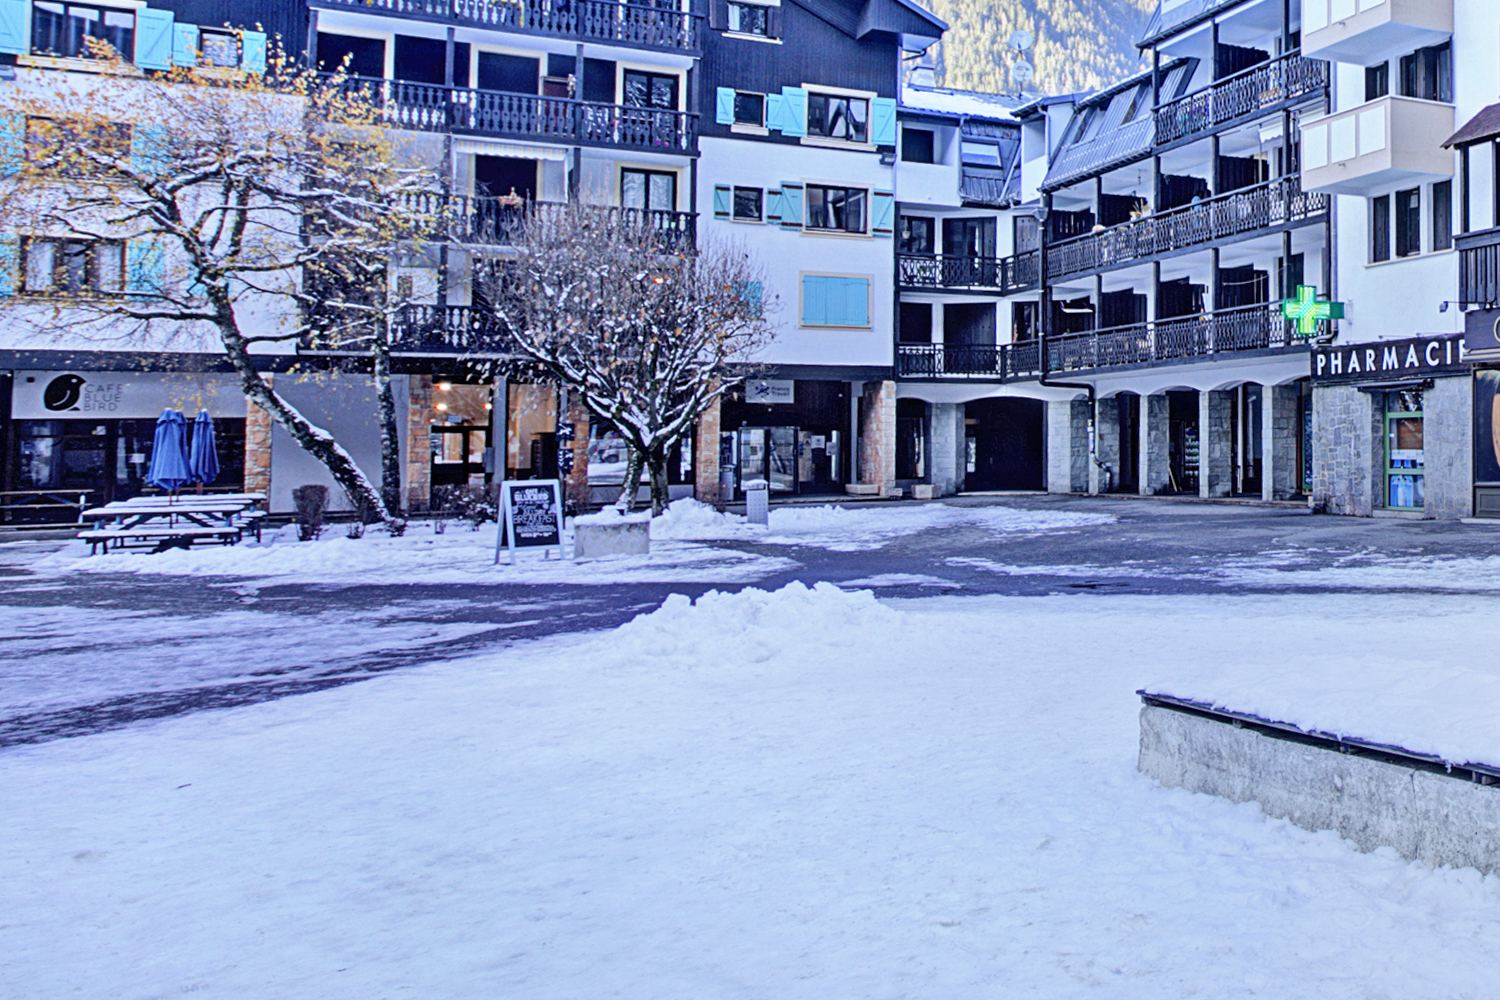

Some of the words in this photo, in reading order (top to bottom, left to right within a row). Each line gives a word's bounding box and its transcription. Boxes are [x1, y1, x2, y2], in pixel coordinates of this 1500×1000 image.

[84, 383, 123, 393] CAFE
[84, 393, 121, 403] BLUE
[84, 402, 117, 411] BIRD
